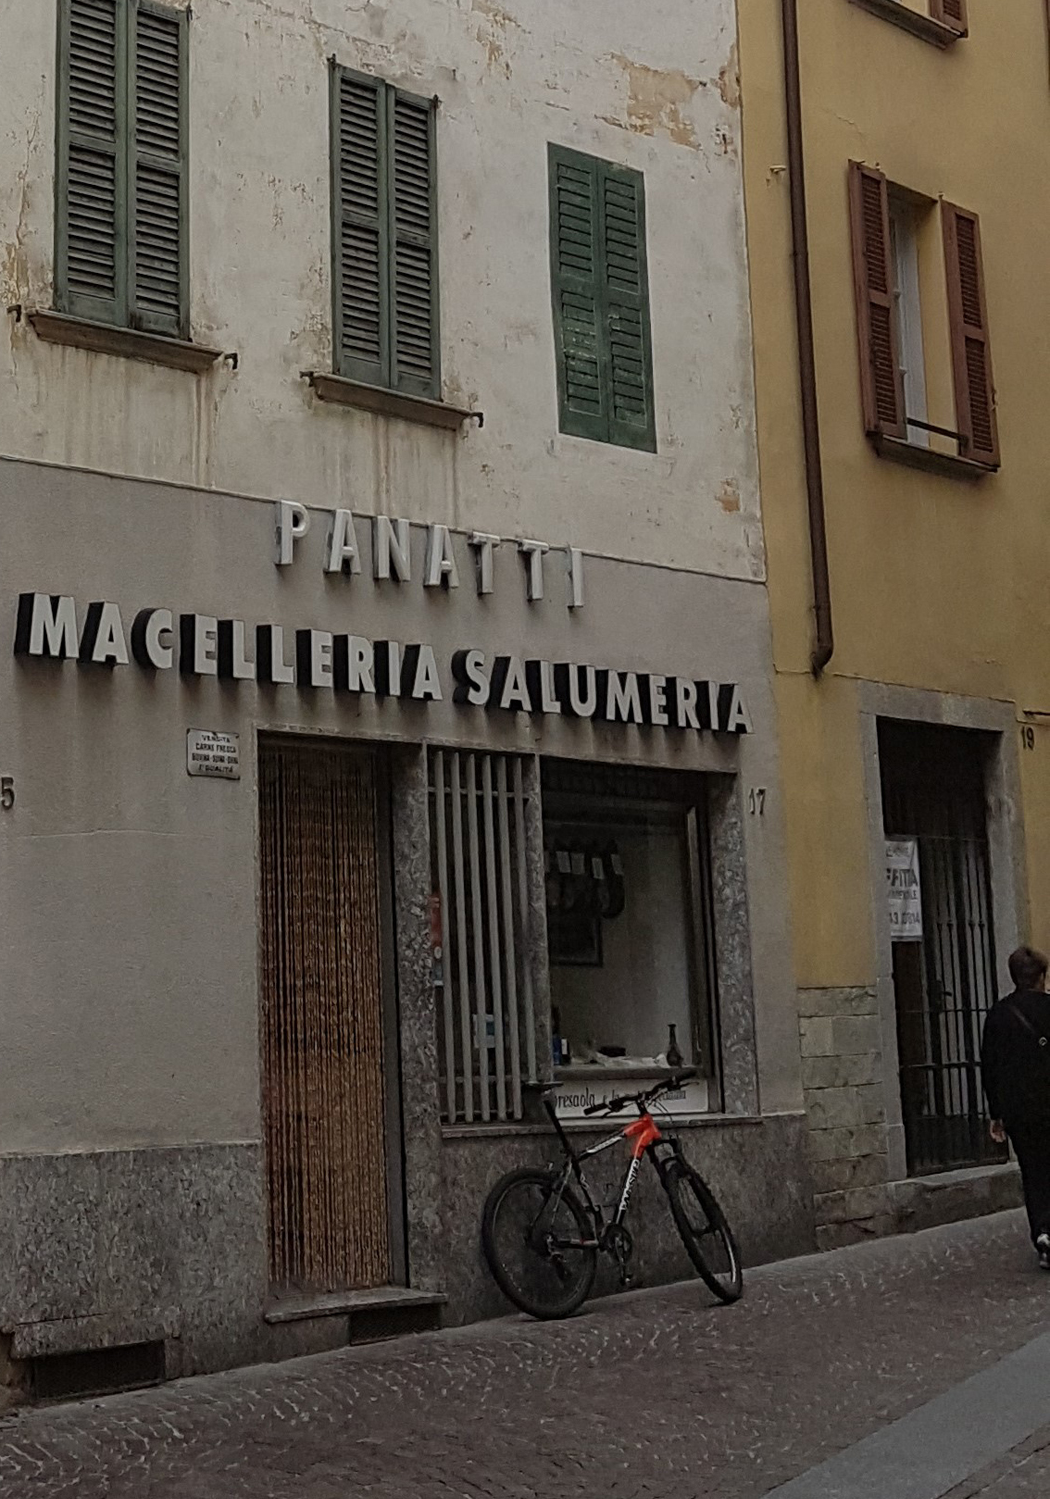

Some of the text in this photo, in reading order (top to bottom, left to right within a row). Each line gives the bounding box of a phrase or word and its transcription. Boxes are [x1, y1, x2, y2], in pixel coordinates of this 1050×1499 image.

[275, 500, 585, 608] PANATTI
[15, 591, 752, 734] MACELLERIA SALUMERIA
[1020, 726, 1035, 750] 19
[749, 787, 766, 815] 17
[555, 1087, 595, 1109] resaola
